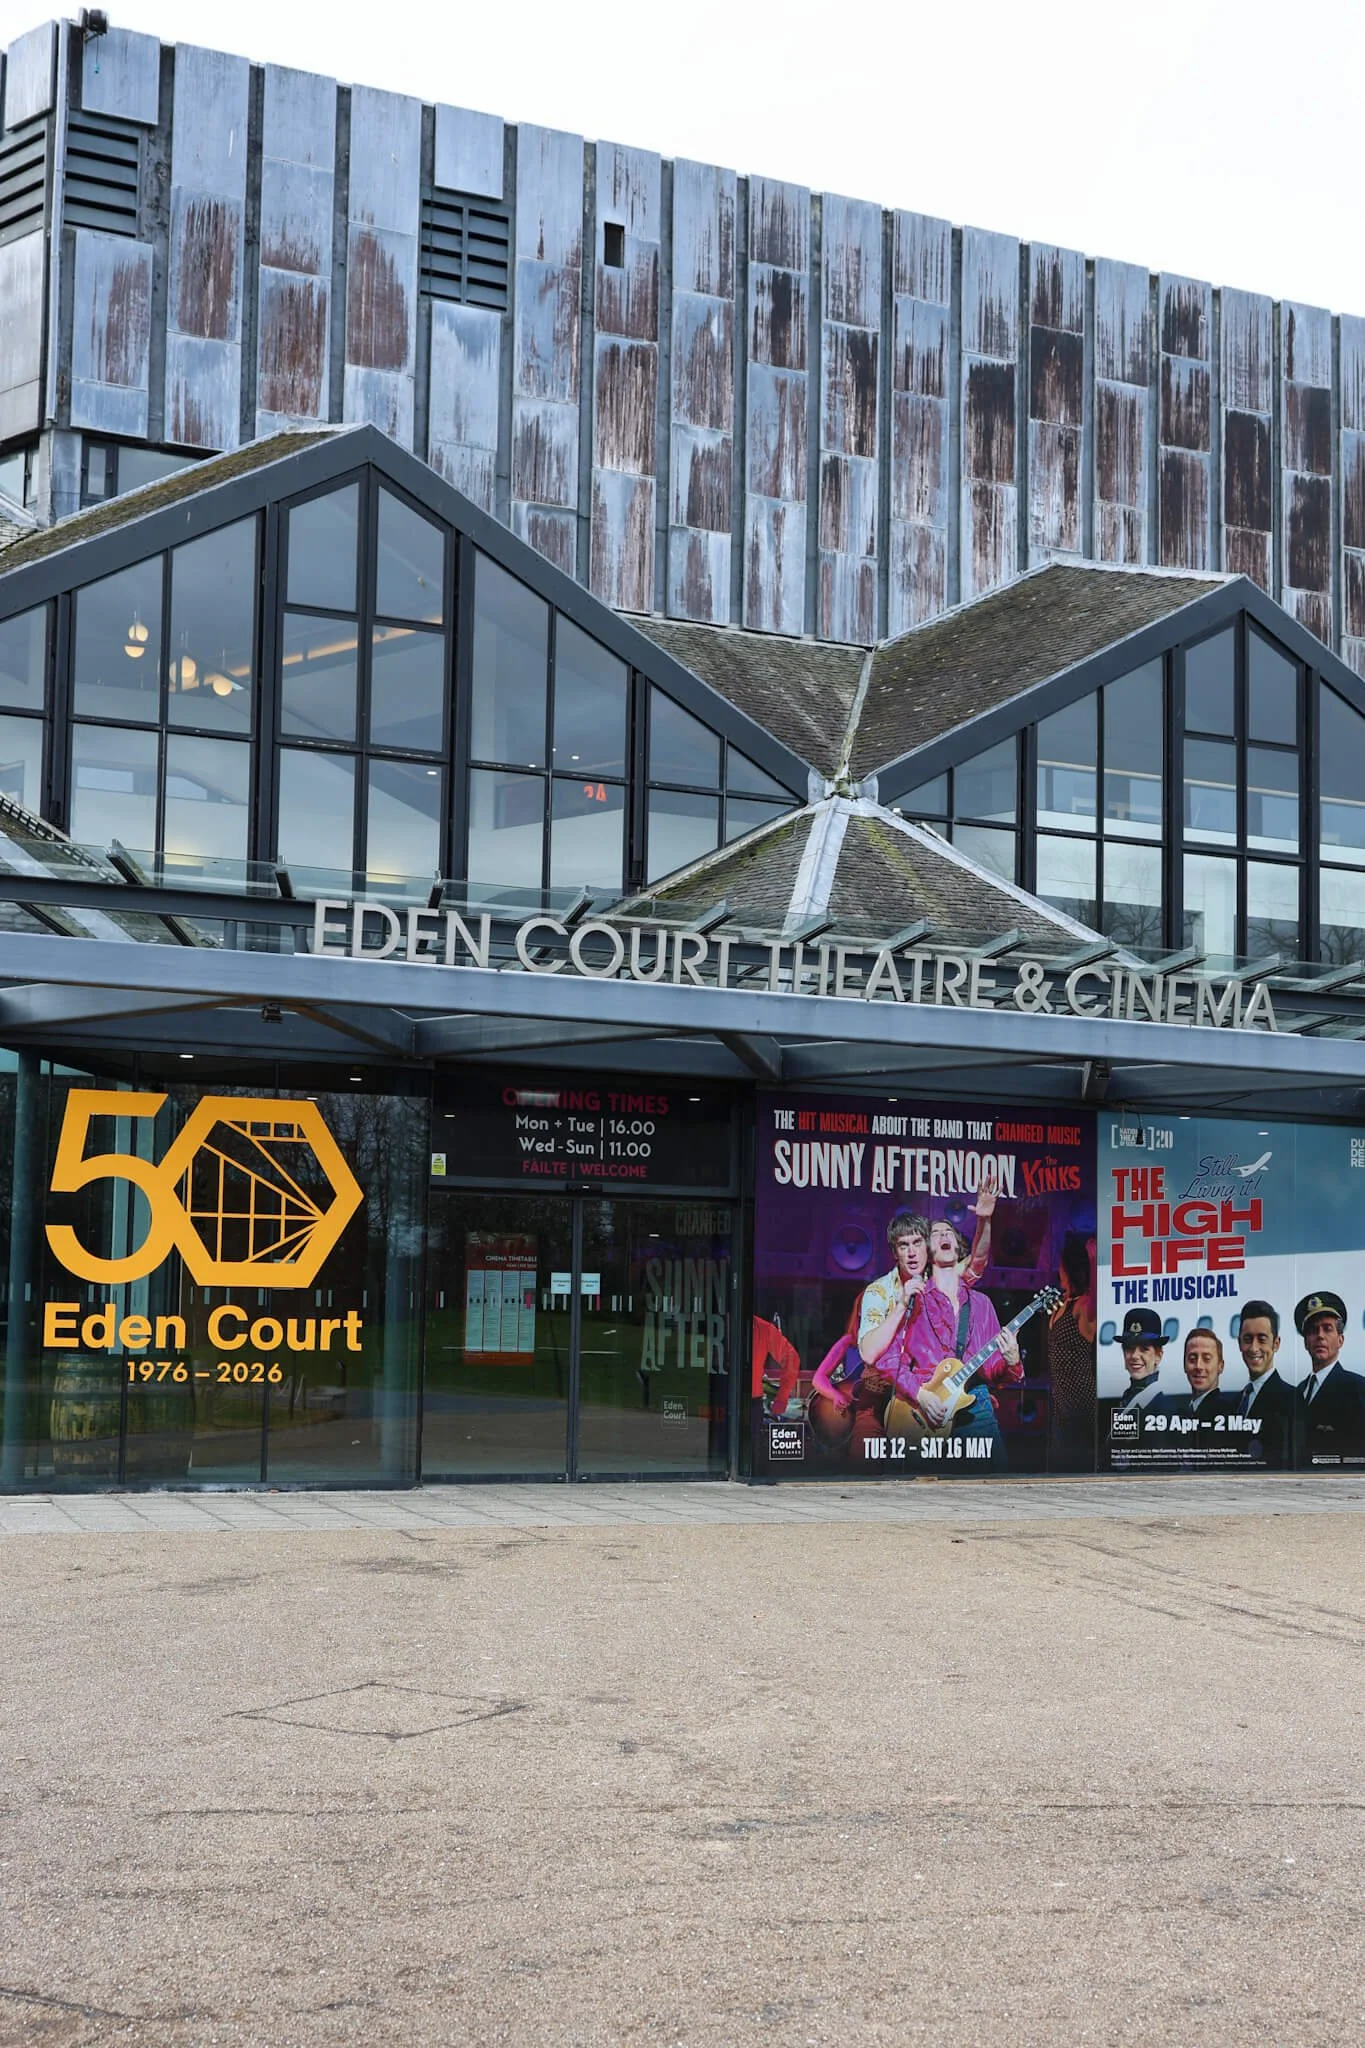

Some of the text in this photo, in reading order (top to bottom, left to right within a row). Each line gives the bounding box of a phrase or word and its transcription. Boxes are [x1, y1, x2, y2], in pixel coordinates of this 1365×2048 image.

[314, 899, 1278, 1032] EDEN COURT THEATRE & CINEMA
[501, 1087, 669, 1115] OPENING TIMES
[515, 1114, 549, 1130] Mon
[567, 1117, 596, 1133] Tue
[609, 1120, 656, 1135] 16.00
[774, 1109, 1081, 1145] THE HIT MUSICAL ABOUT THE BAND THAT CHANGED MUSIC
[609, 1142, 652, 1157] 11.00
[580, 1163, 647, 1178] WELCOME
[774, 1139, 1018, 1199] SUNNY AFTERNOON
[1196, 1152, 1239, 1177] Still
[1111, 1167, 1165, 1202] THE
[1178, 1174, 1264, 1204] Living it!
[1111, 1198, 1263, 1239] HIGH
[1111, 1236, 1245, 1277] LIFE
[1111, 1274, 1238, 1304] THE MUSICAL
[43, 1302, 363, 1351] Eden Court
[127, 1361, 188, 1383] 1976
[216, 1362, 283, 1383] 2026
[663, 1400, 683, 1410] Eden
[663, 1410, 686, 1420] Court
[1113, 1412, 1134, 1421] Eden
[1113, 1421, 1137, 1430] Court
[1144, 1414, 1168, 1431] 29
[1169, 1415, 1200, 1434] Apr
[1214, 1415, 1225, 1431] 2
[1227, 1415, 1263, 1434] May
[772, 1428, 797, 1438] Eden
[772, 1439, 802, 1449] Court
[863, 1437, 887, 1459] TUE
[890, 1437, 906, 1458] 12
[920, 1437, 945, 1458] SAT
[946, 1437, 962, 1458] 16
[965, 1437, 993, 1458] MAY
